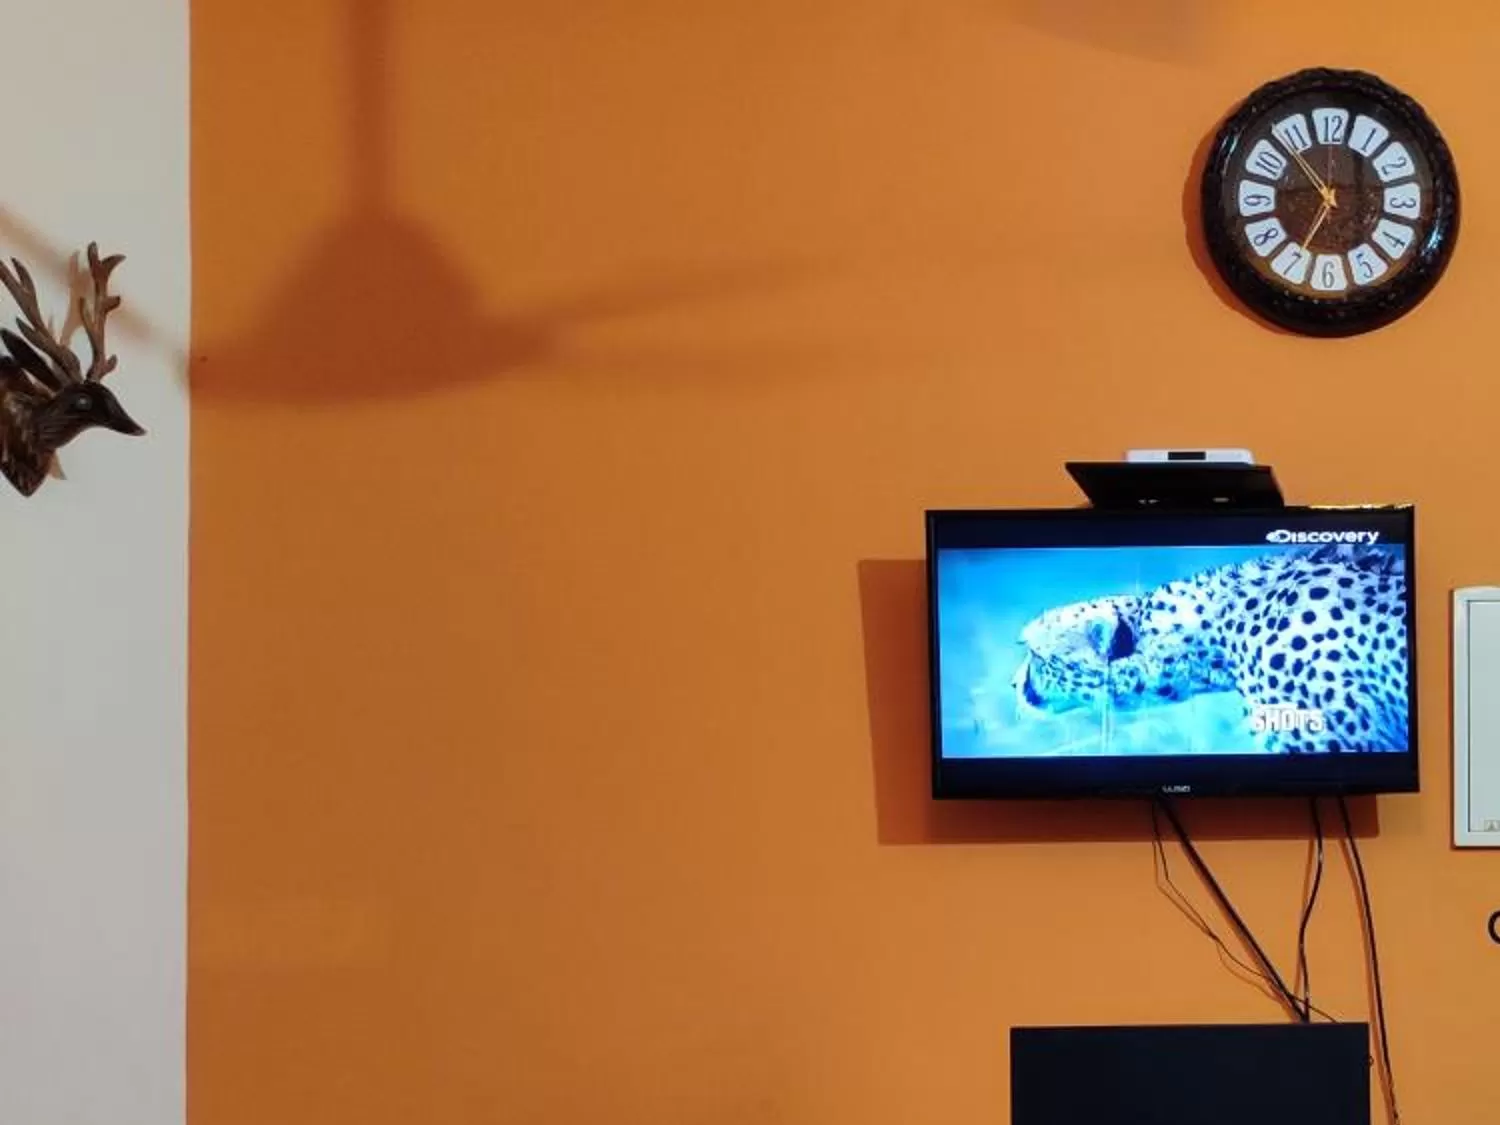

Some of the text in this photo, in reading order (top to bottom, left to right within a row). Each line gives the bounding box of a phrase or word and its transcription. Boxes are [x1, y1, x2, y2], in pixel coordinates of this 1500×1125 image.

[1284, 124, 1307, 151] 11
[1322, 115, 1343, 142] 12
[1362, 127, 1378, 150] 1
[1255, 151, 1284, 176] 10
[1382, 156, 1407, 175] 2
[1243, 193, 1271, 207] 9
[1389, 193, 1417, 209] 3
[1253, 226, 1279, 247] 8
[1382, 230, 1405, 250] 4
[1283, 251, 1303, 276] 7
[1322, 262, 1335, 289] 6
[1355, 253, 1374, 279] 5
[1266, 529, 1379, 544] Discovery
[1253, 706, 1324, 732] SHOTS
